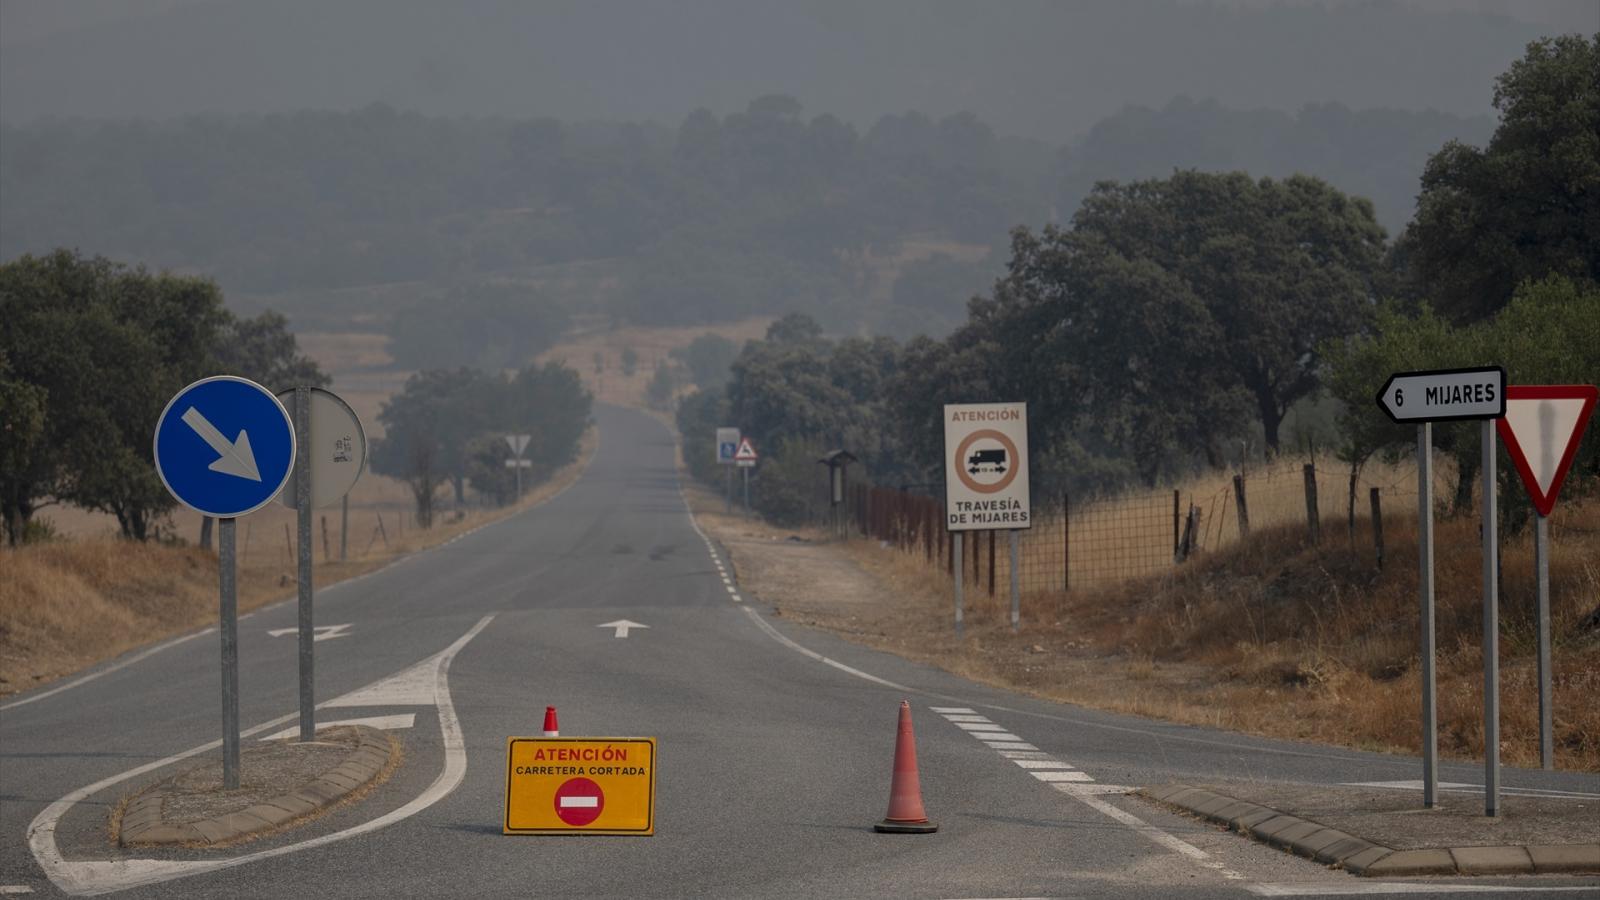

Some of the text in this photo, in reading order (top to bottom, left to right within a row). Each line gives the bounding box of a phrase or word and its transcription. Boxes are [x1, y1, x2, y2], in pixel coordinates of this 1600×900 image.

[1394, 383, 1495, 407] 6 MIJARES
[951, 407, 1020, 422] ATENCIÓN
[955, 497, 1021, 512] TRAVESÍA
[949, 511, 1028, 524] DE MIJARES
[534, 744, 627, 761] ATENCIÓN
[515, 766, 646, 776] CARRETERA CORTADA
